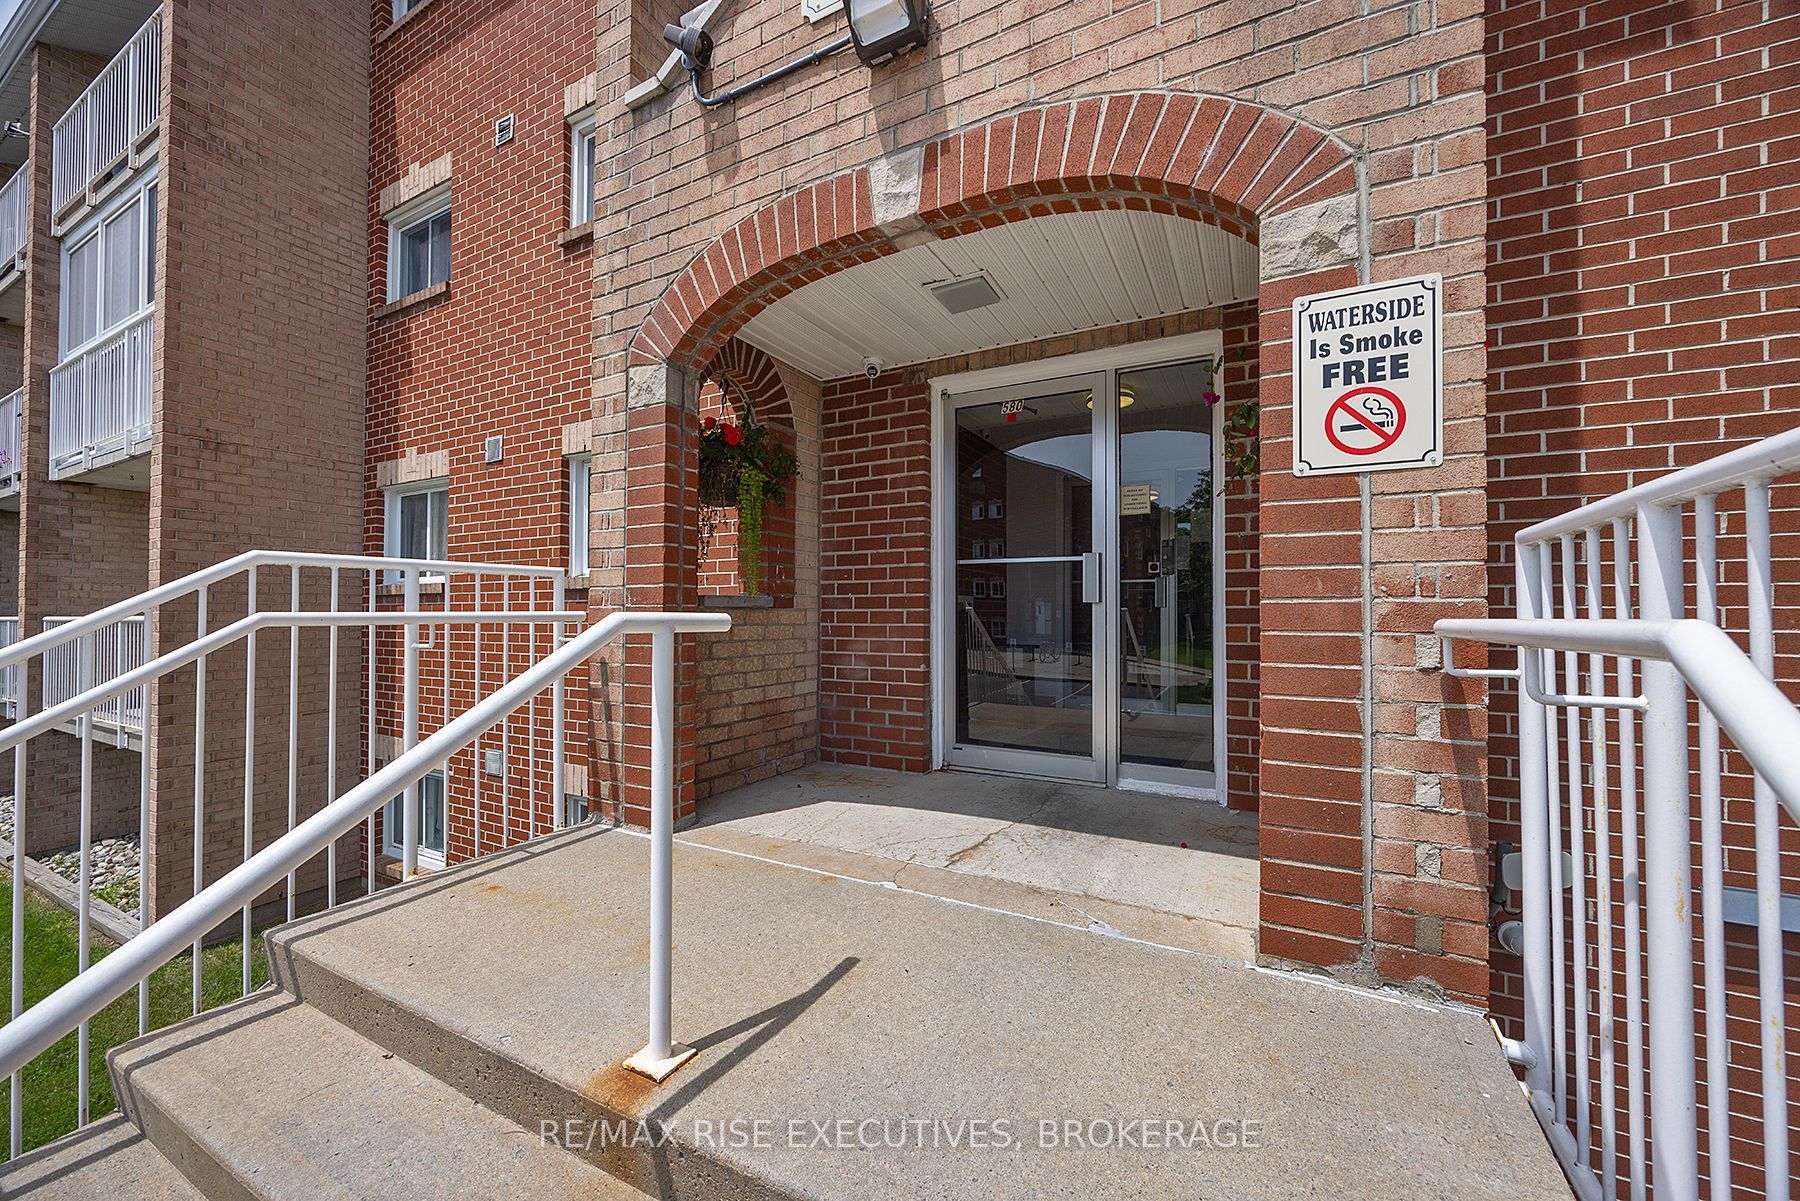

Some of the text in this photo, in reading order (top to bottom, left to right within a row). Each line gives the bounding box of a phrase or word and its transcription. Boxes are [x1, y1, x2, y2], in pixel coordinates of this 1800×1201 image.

[1308, 295, 1425, 333] WATERSIDE
[1309, 326, 1423, 360] Is Smoke
[1322, 353, 1409, 389] FREE
[1002, 400, 1023, 413] 580
